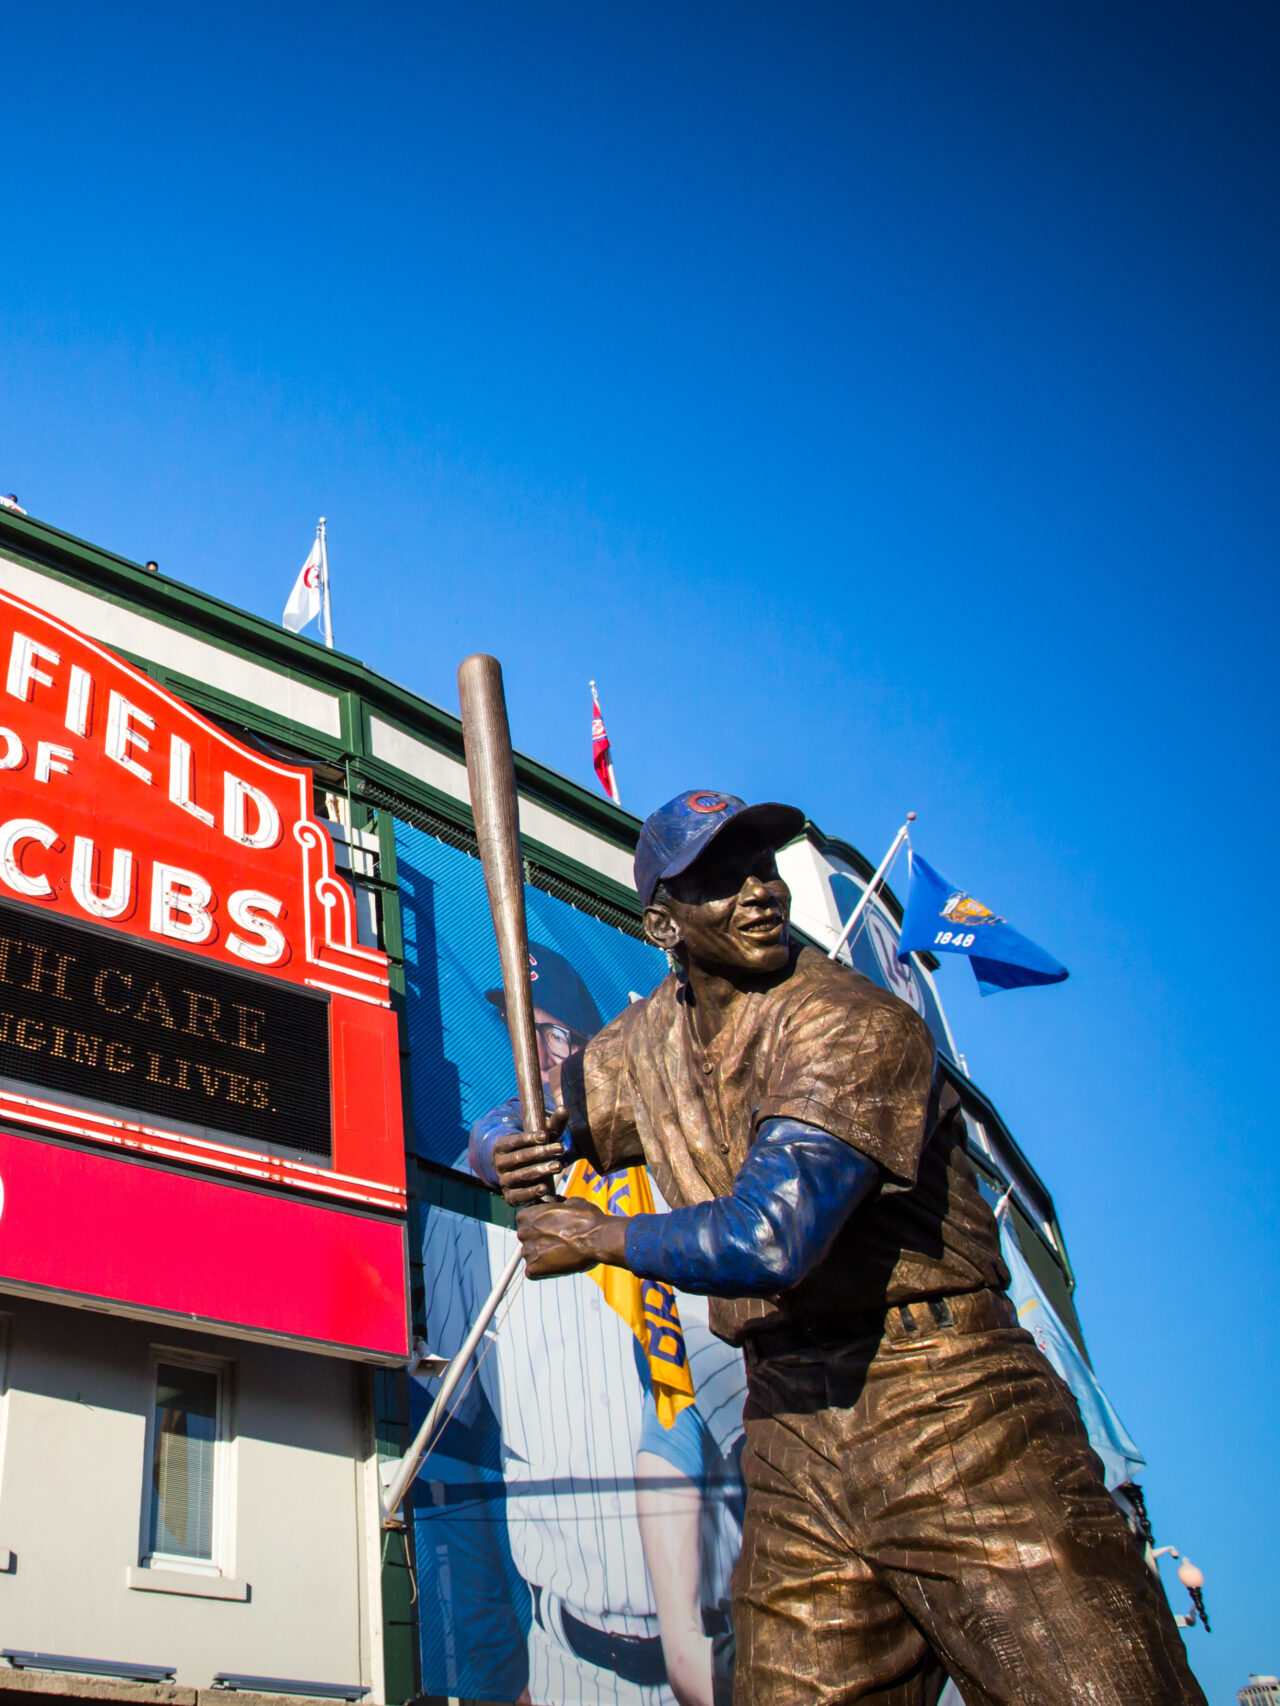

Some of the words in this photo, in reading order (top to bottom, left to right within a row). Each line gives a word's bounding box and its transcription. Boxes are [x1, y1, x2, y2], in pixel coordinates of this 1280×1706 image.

[6, 631, 282, 850] FIELD
[687, 792, 728, 814] C
[933, 931, 976, 948] 1848
[93, 969, 266, 1054] CARE
[145, 1051, 277, 1112] LIVES.
